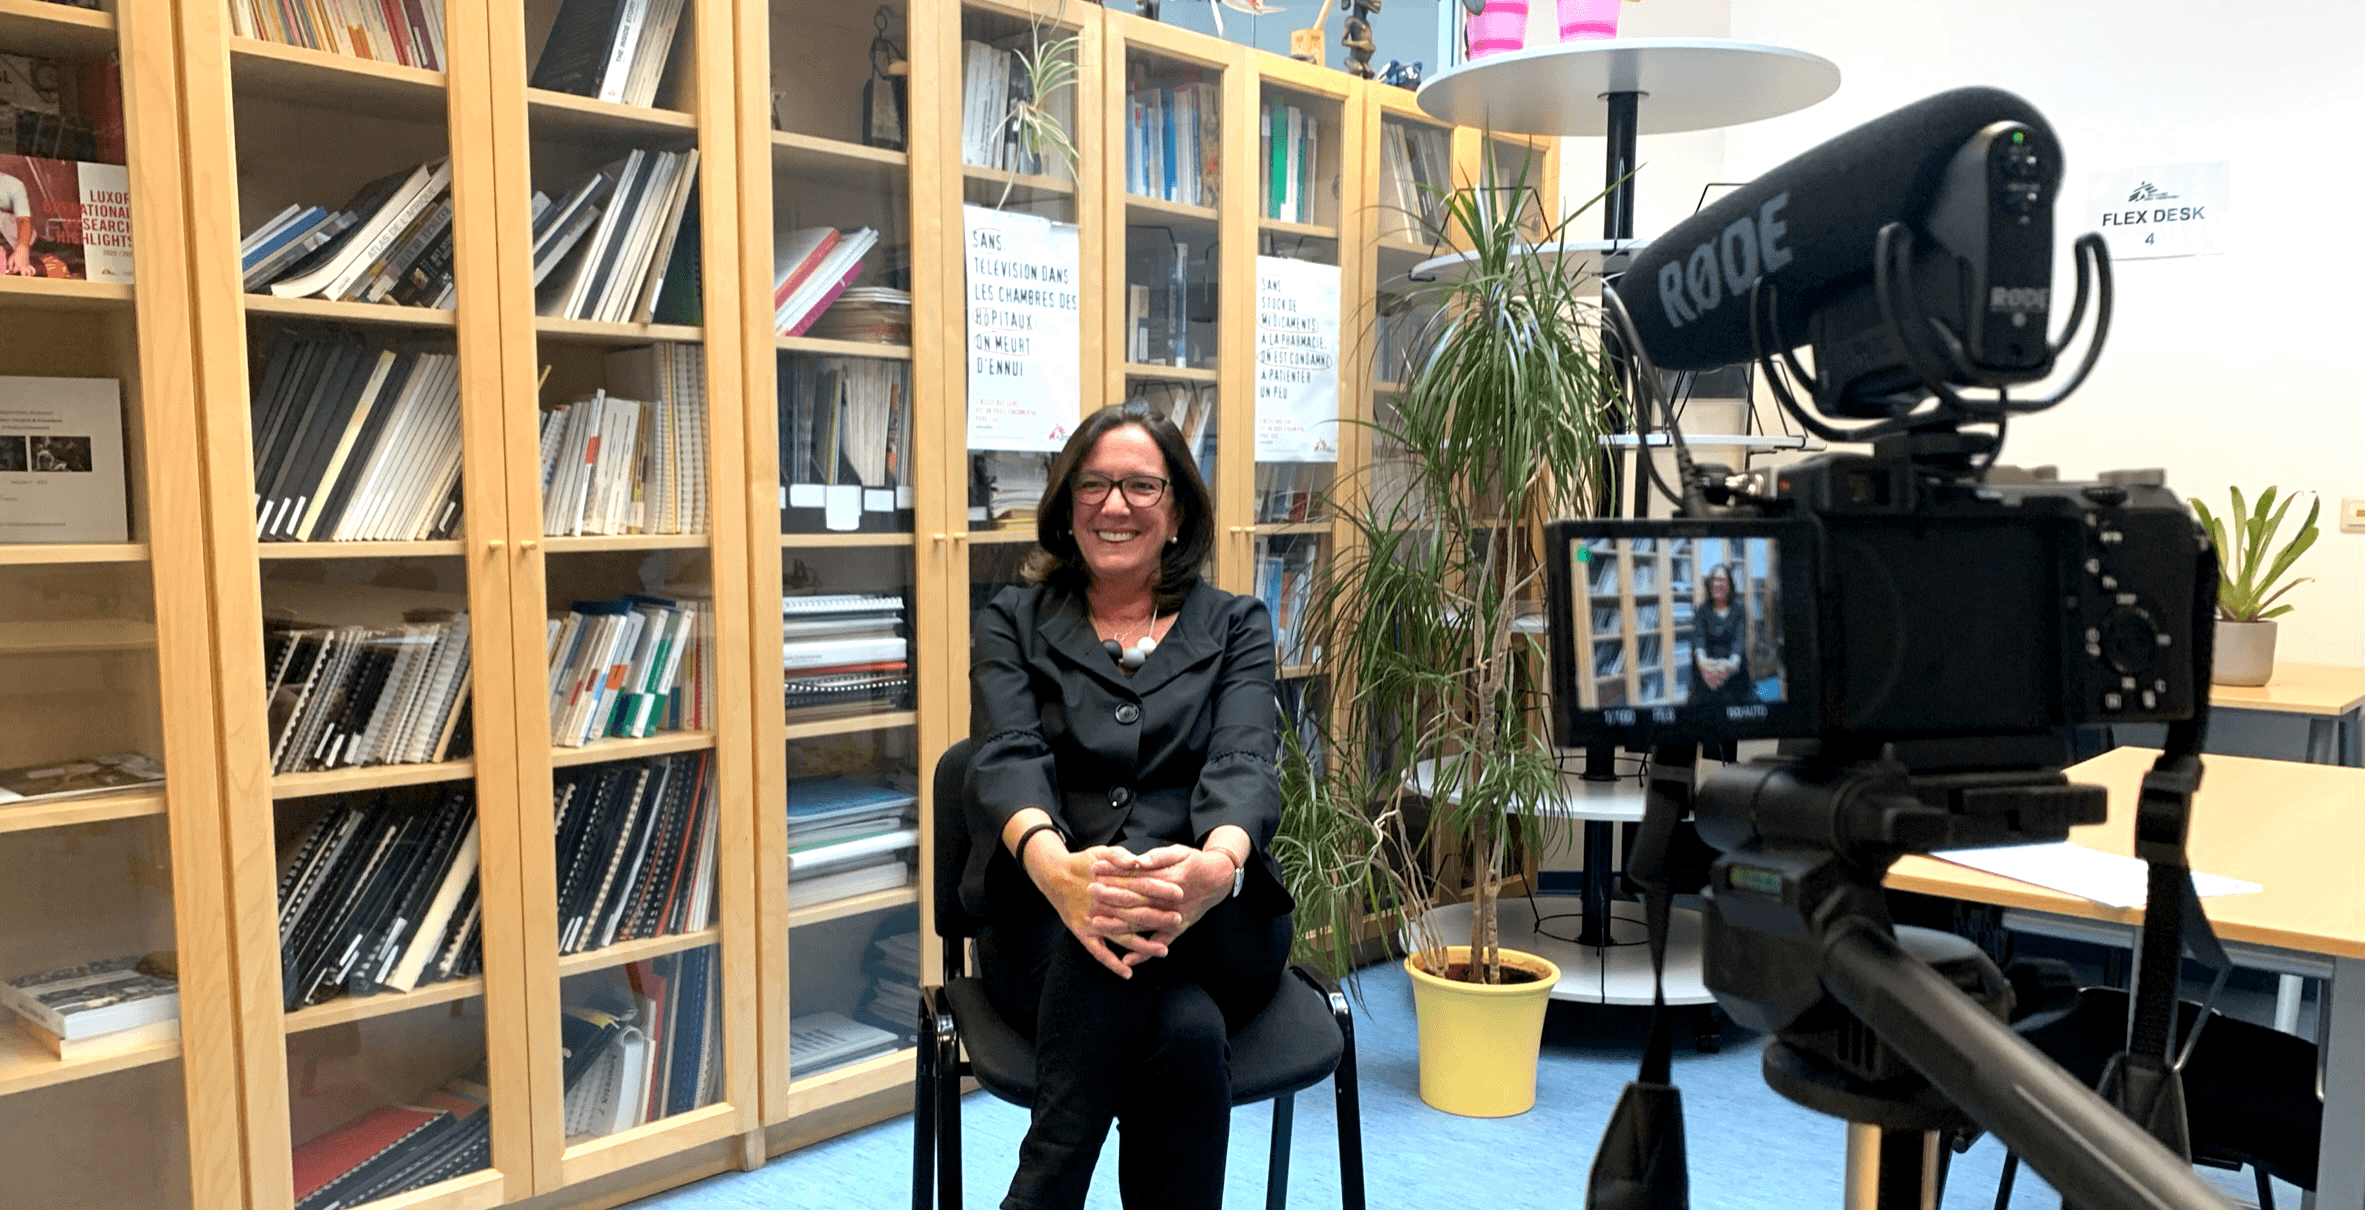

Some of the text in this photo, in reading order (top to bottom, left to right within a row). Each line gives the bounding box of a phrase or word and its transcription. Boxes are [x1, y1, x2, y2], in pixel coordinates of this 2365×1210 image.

[2102, 205, 2206, 227] FLEX DESK
[973, 229, 1002, 251] SANS
[2144, 232, 2155, 245] 4
[1658, 191, 1793, 328] RØDE
[1042, 265, 1069, 285] DANS
[1262, 277, 1281, 293] SANS
[975, 283, 1077, 311] LES CHAMBRES DES
[1262, 296, 1298, 313] STOCK DE
[976, 333, 1031, 356] ON MEURT
[1269, 332, 1280, 346] LA
[1260, 349, 1271, 364] ON
[1274, 350, 1288, 364] EST
[977, 356, 1023, 377] D'ENNUI
[1269, 368, 1312, 385] PATIENTER
[1260, 385, 1288, 400] UN PEU
